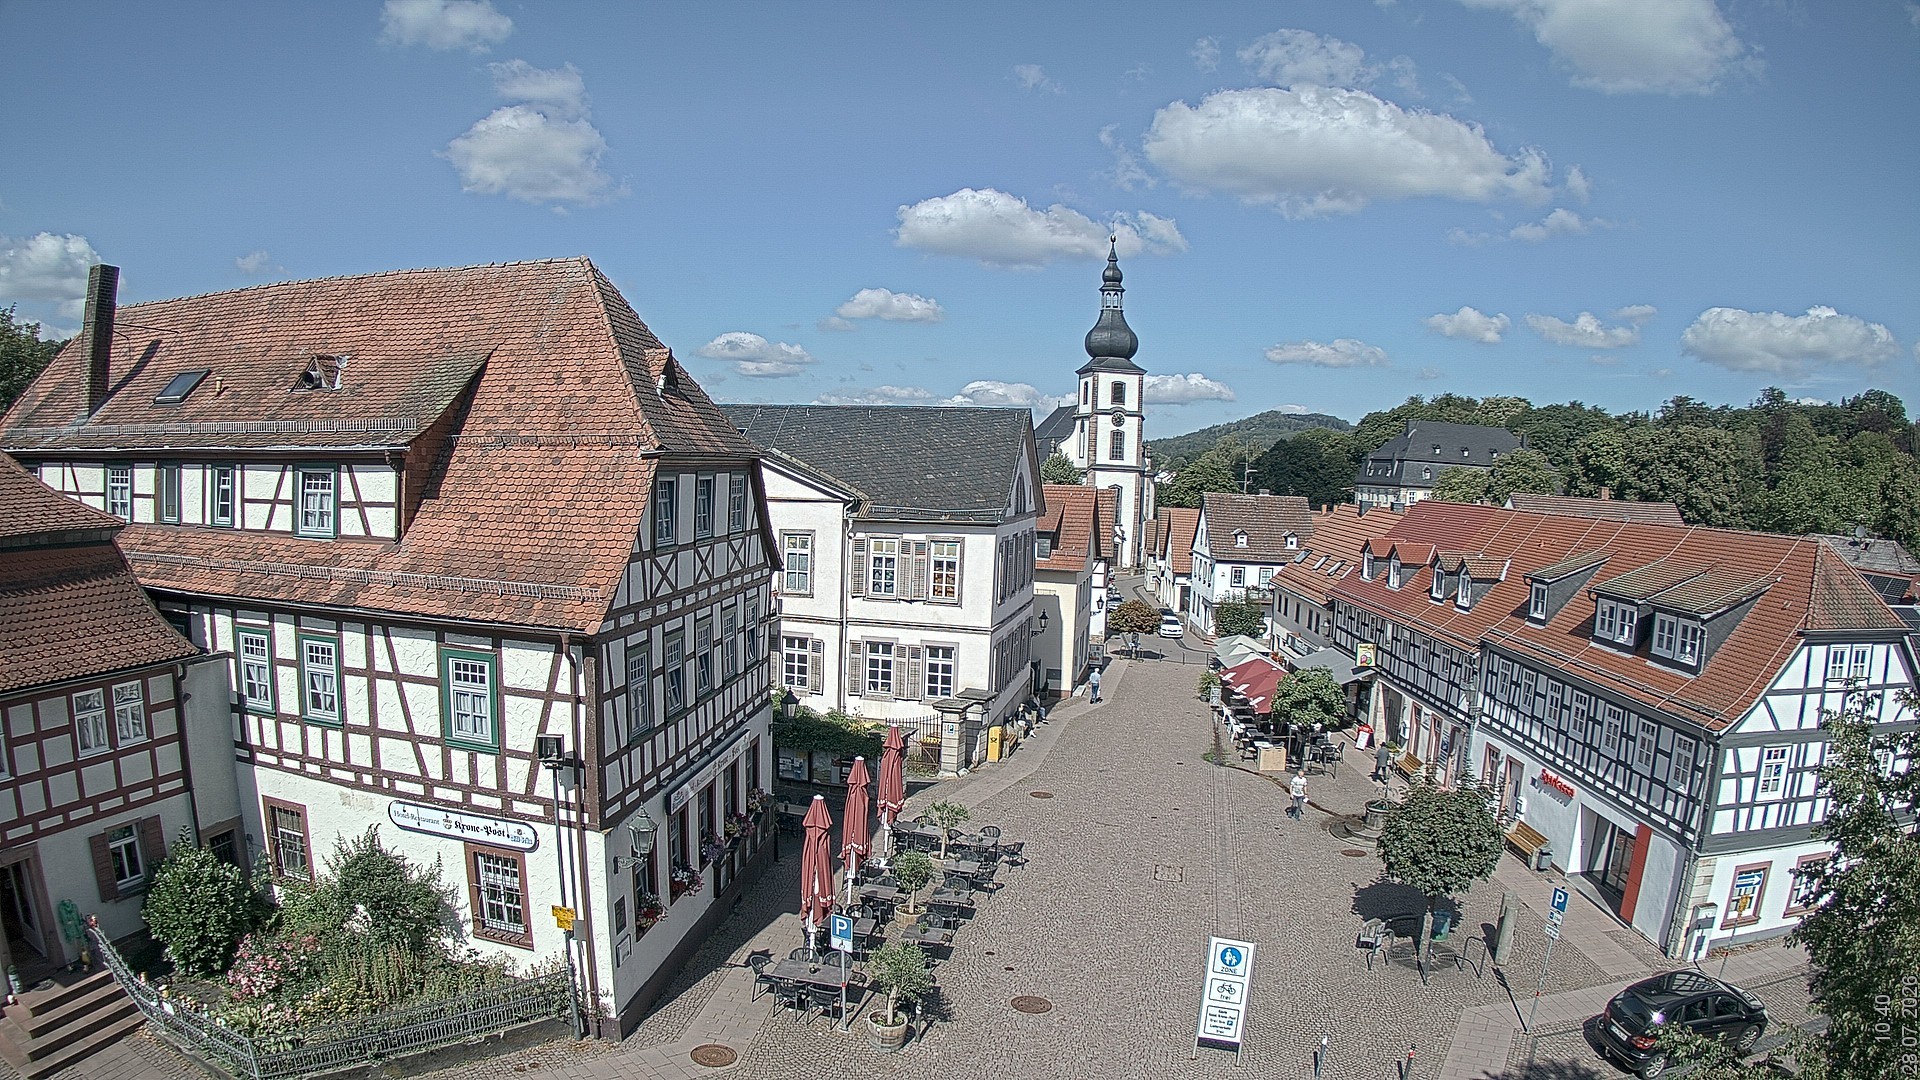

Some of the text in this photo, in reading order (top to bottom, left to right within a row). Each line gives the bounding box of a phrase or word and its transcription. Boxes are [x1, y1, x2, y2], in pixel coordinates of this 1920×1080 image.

[1554, 891, 1565, 907] P
[836, 918, 848, 935] P
[1221, 966, 1238, 974] ZONE
